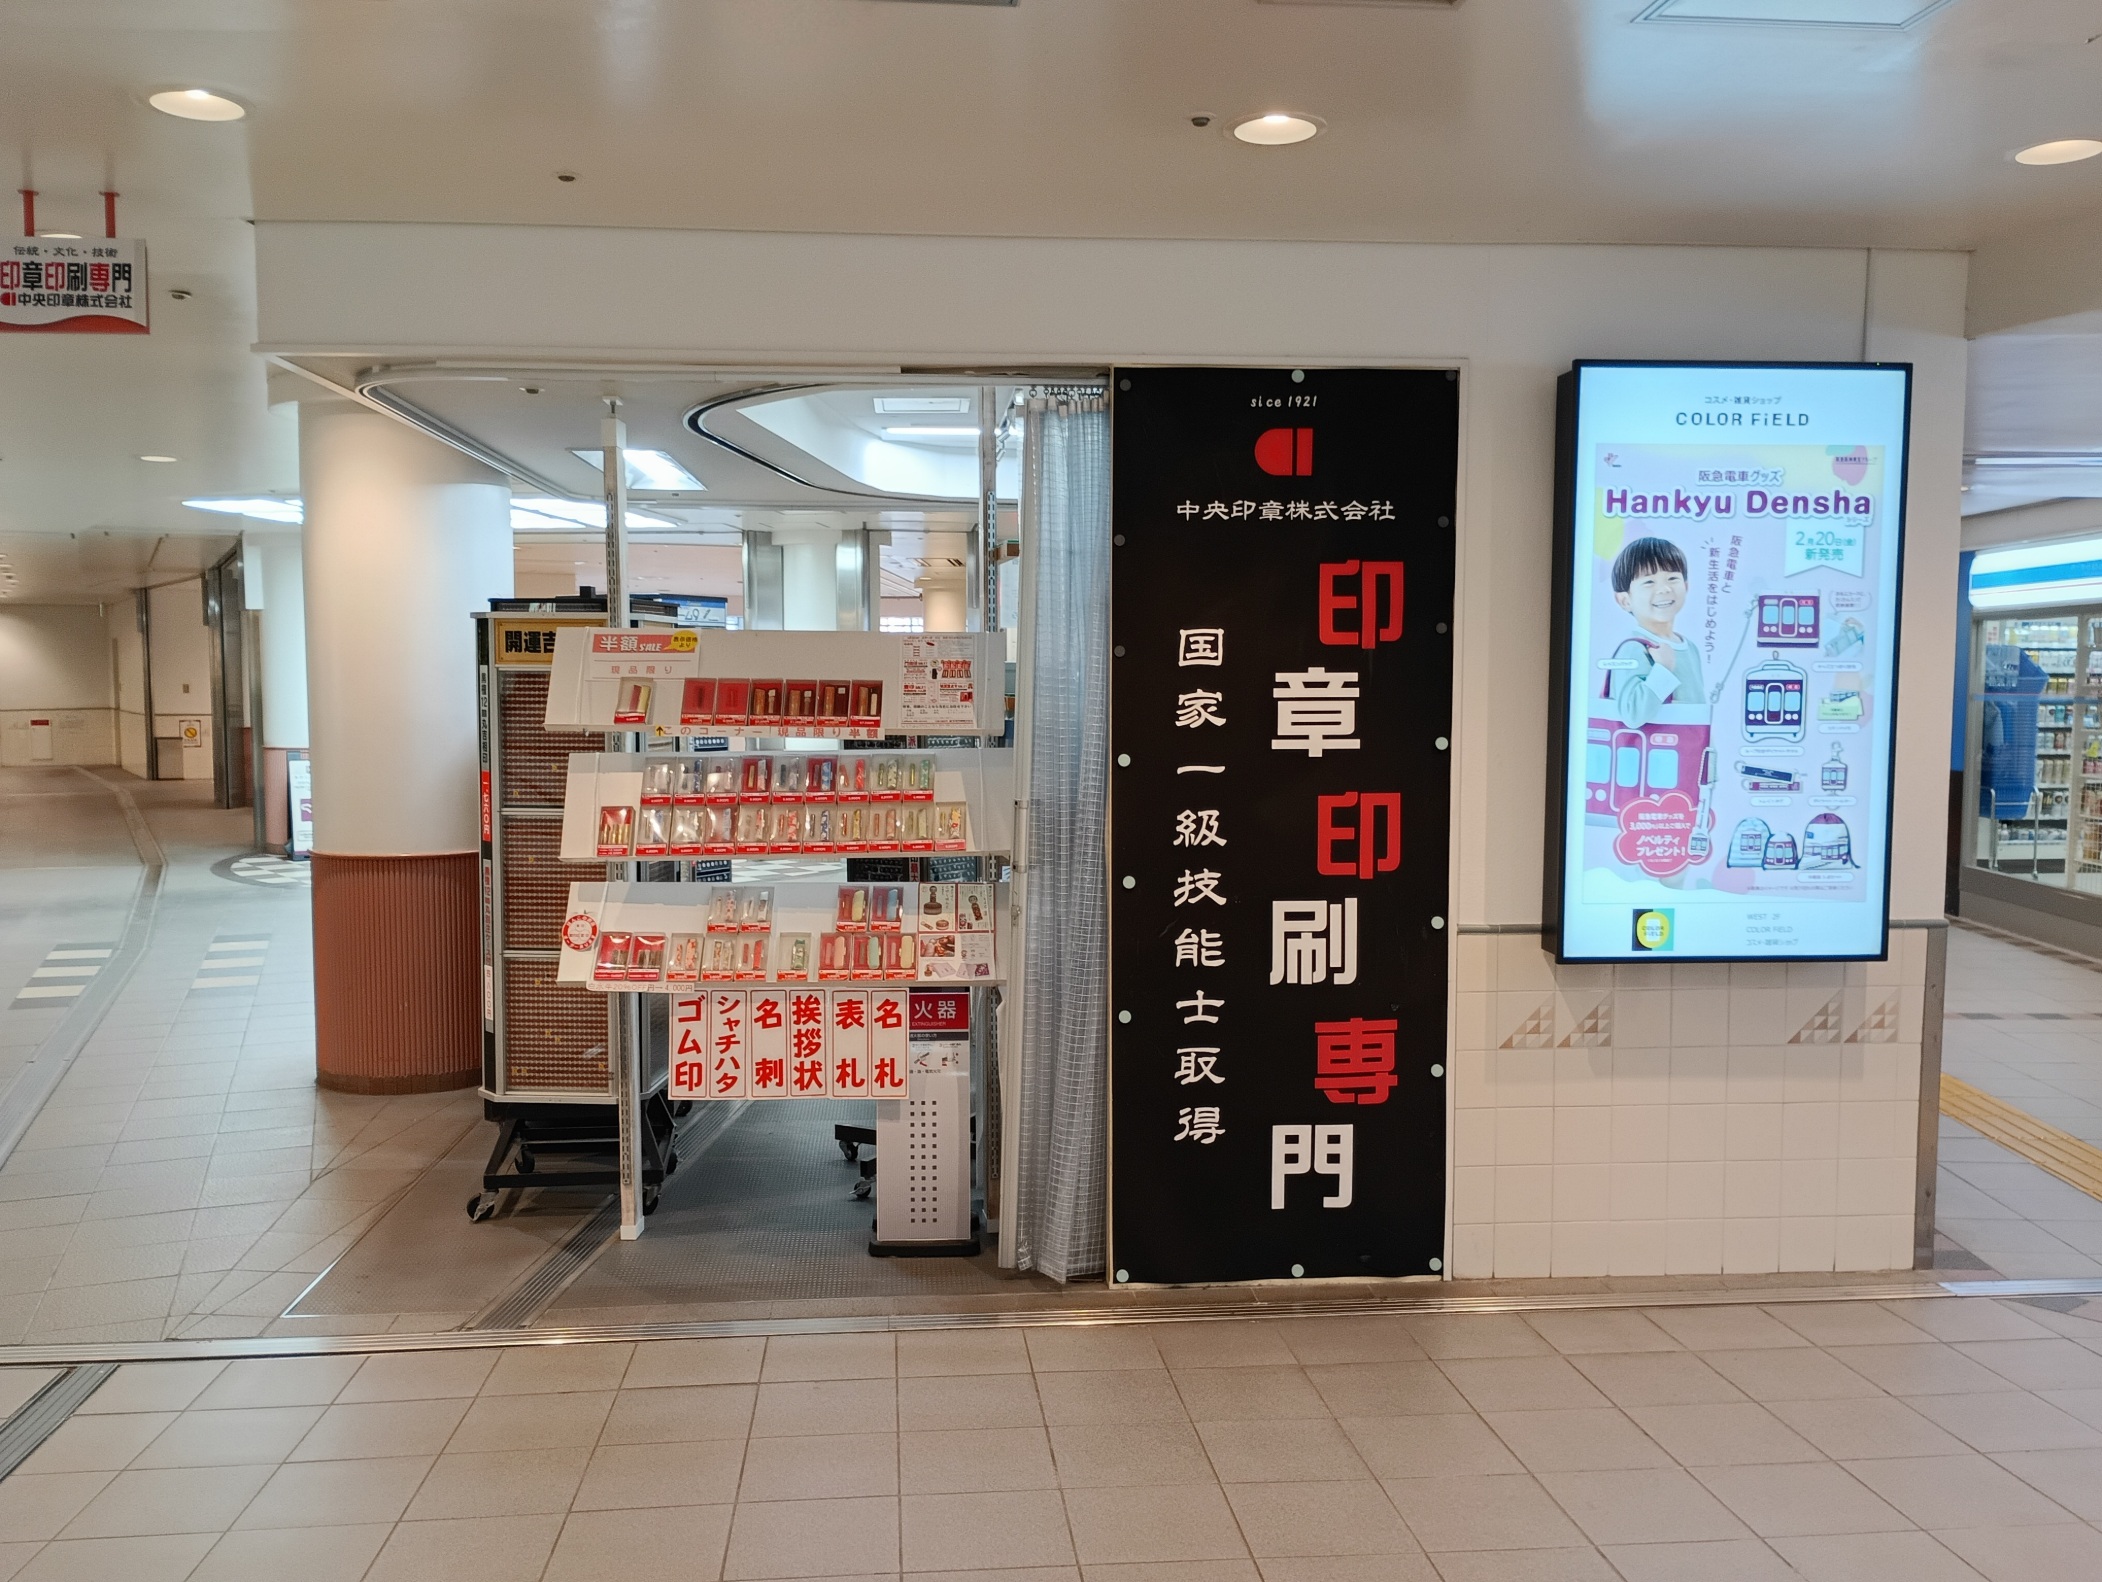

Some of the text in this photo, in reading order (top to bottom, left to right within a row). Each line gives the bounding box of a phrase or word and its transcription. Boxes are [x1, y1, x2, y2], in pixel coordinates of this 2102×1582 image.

[13, 246, 118, 258] 伝統・文化・技術
[0, 260, 132, 293] 印章印刷専門
[18, 293, 133, 309] 中央印章株式会社
[1250, 395, 1318, 408] sice 1921
[1676, 412, 1743, 426] COLOR
[1698, 470, 1782, 484] 阪急電車グッズ
[1176, 499, 1396, 522] 中央印章株式会社
[1606, 489, 1871, 515] Hankyu Densha
[1721, 535, 1743, 594] 阪急電車と
[1805, 548, 1844, 561] 新発売
[600, 635, 663, 652] 半額 SALE
[611, 665, 673, 675] 現品限り
[663, 726, 763, 737] このコーナー
[1635, 835, 1681, 846] ノベルティ
[1173, 627, 1228, 1145] 国家一級技能士取得
[1269, 559, 1405, 1210] 印章印刷専門
[1746, 913, 1768, 921] WEST
[674, 994, 706, 1092] ゴム印
[714, 995, 741, 1094] シャチハタ
[753, 998, 784, 1089] 名刺
[791, 994, 824, 1091] 挨拶状
[835, 999, 866, 1089] 表札
[873, 998, 904, 1089] 名札
